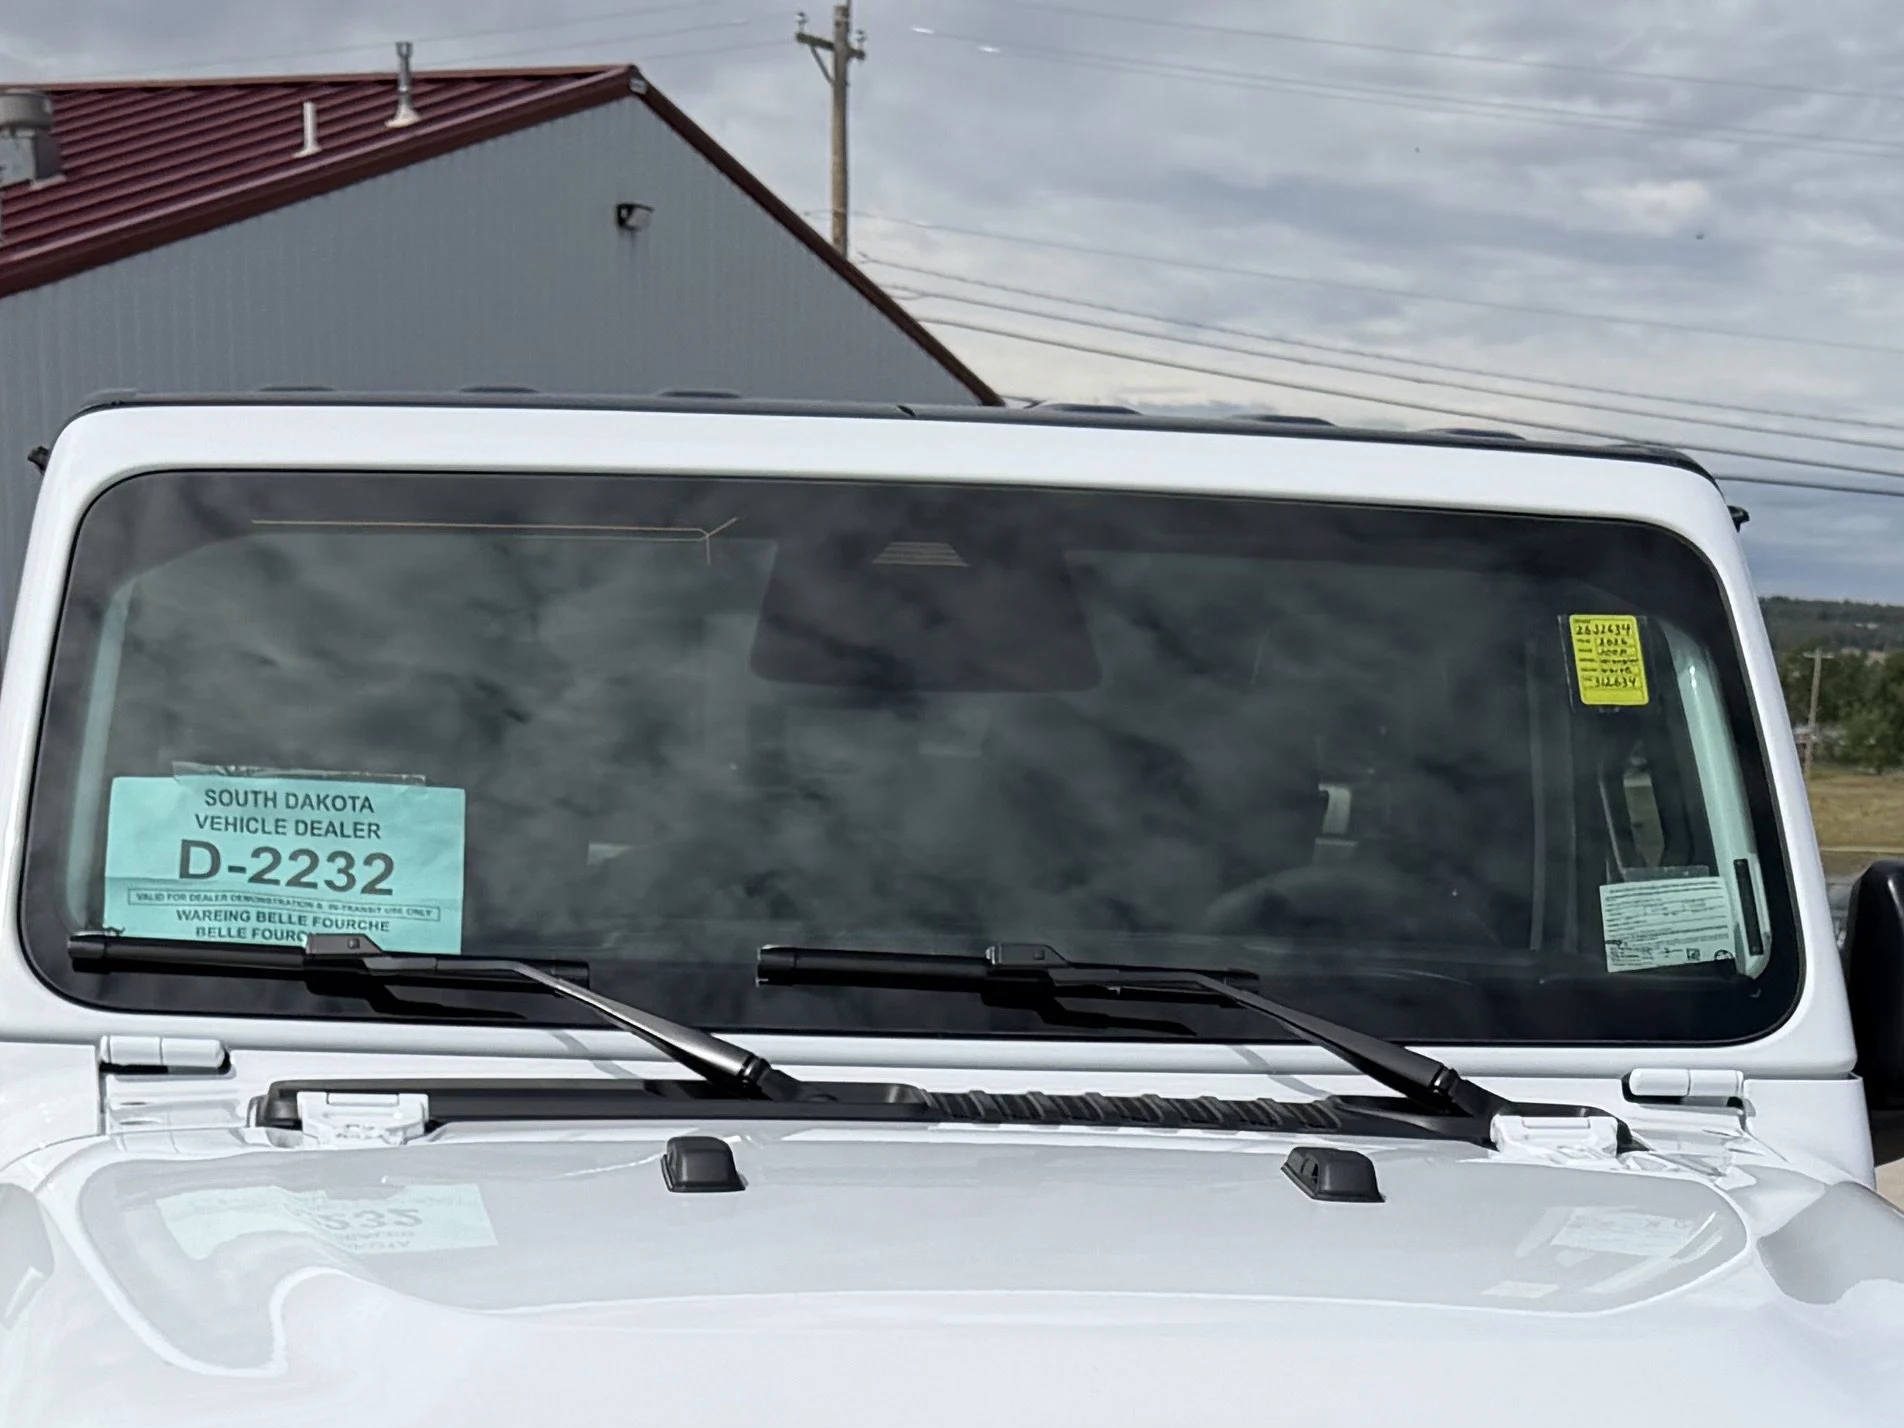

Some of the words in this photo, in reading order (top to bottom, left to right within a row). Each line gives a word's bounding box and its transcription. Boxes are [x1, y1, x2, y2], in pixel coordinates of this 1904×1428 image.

[204, 788, 277, 809] SOUTH
[285, 792, 375, 814] DAKOTA
[195, 814, 287, 836] VEHICLE
[295, 819, 381, 840] DEALER
[179, 838, 395, 896] D-2232
[136, 893, 164, 901] VALID
[167, 893, 187, 901] FOR
[189, 893, 228, 902] DEALER
[176, 909, 251, 923] WAREING
[256, 911, 307, 926] BELLE
[313, 916, 390, 932] FOURCHE
[196, 926, 246, 939] BELLE
[252, 928, 307, 942] FOURC
